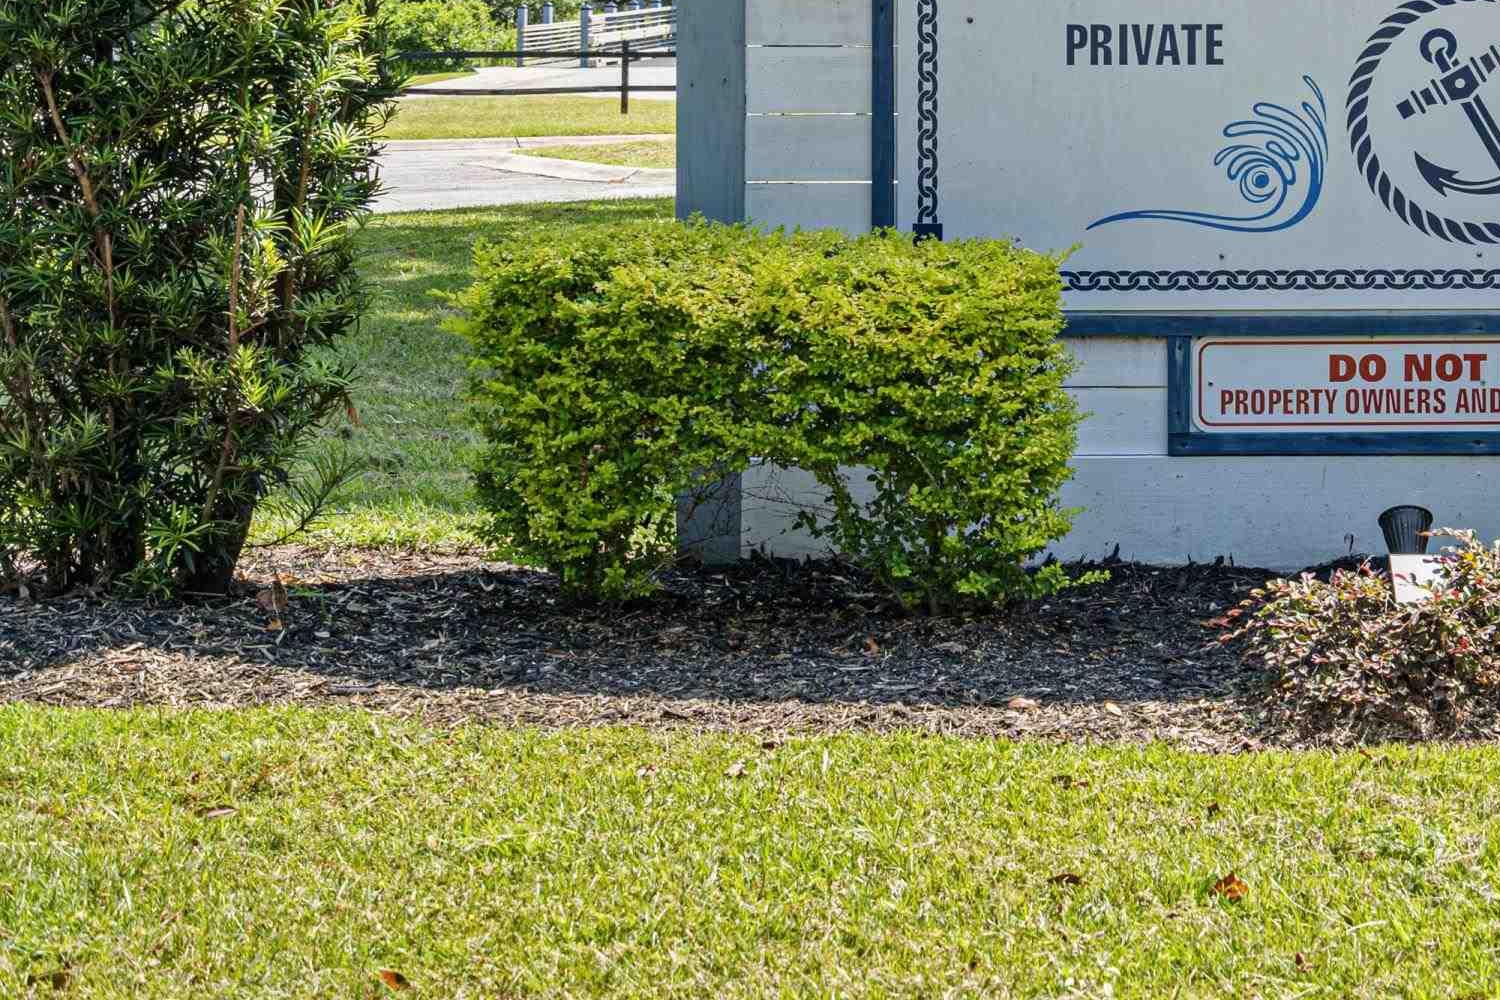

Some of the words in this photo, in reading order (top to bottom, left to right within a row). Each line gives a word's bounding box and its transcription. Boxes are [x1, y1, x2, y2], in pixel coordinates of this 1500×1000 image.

[1066, 23, 1225, 66] PRIVATE
[1328, 353, 1387, 383] DO
[1404, 353, 1488, 382] NOT
[1220, 388, 1338, 415] PROPERTY
[1345, 387, 1447, 414] OWNERS
